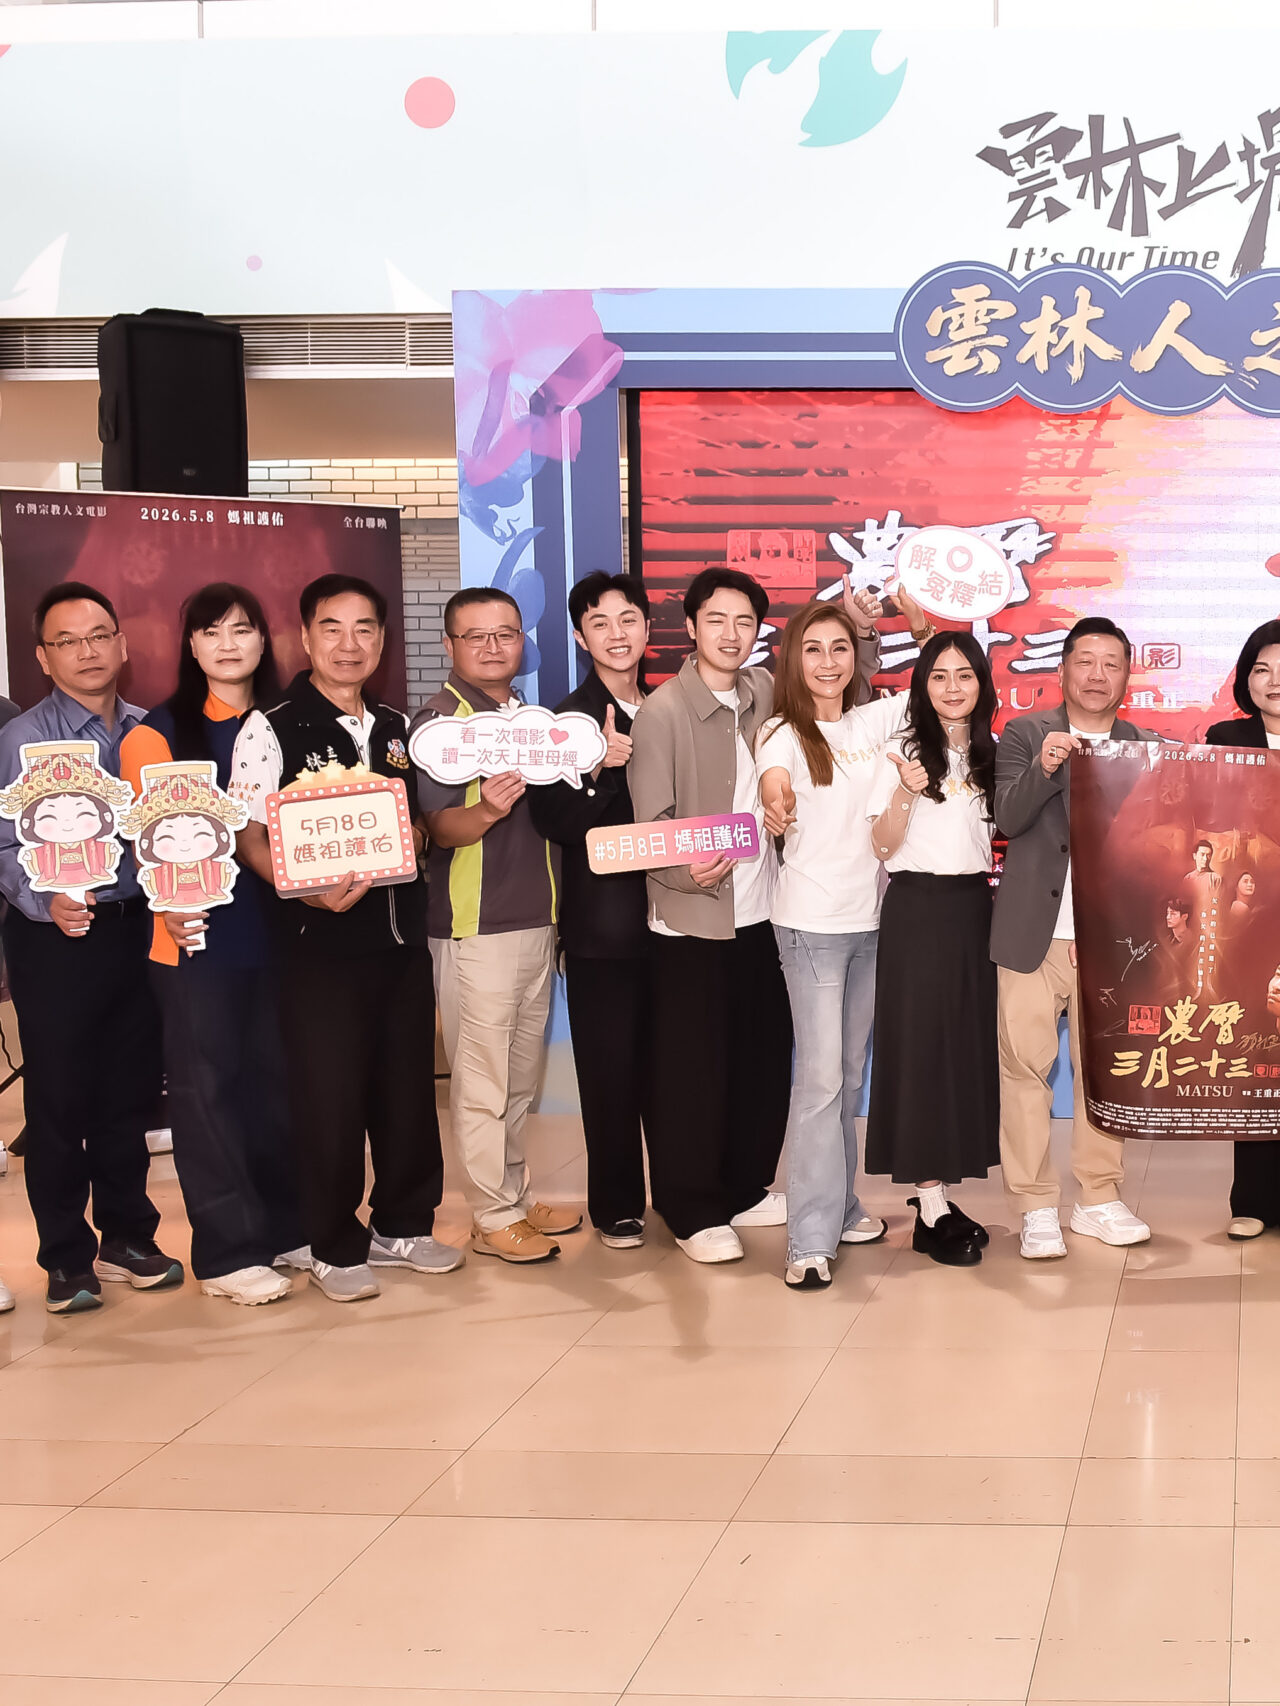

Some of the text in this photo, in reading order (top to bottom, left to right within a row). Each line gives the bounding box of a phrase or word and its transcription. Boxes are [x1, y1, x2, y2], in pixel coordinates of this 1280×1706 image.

[1007, 245, 1220, 272] It's Our Time
[140, 507, 284, 526] 2026.5.8 媽祖護佑
[343, 516, 388, 530] 全台聯映
[1119, 690, 1187, 709] 重正
[460, 727, 546, 746] 看一次電影
[442, 747, 578, 767] 讀一次天上聖母經
[1164, 750, 1267, 766] 2026.5.8 媽祖護佑
[300, 811, 377, 836] 5月8日
[293, 833, 393, 864] 媽祖護佑
[594, 822, 752, 861] #5月8日 媽祖護佑
[1109, 1046, 1253, 1089] 三月二十三
[1175, 1084, 1234, 1098] MATSU
